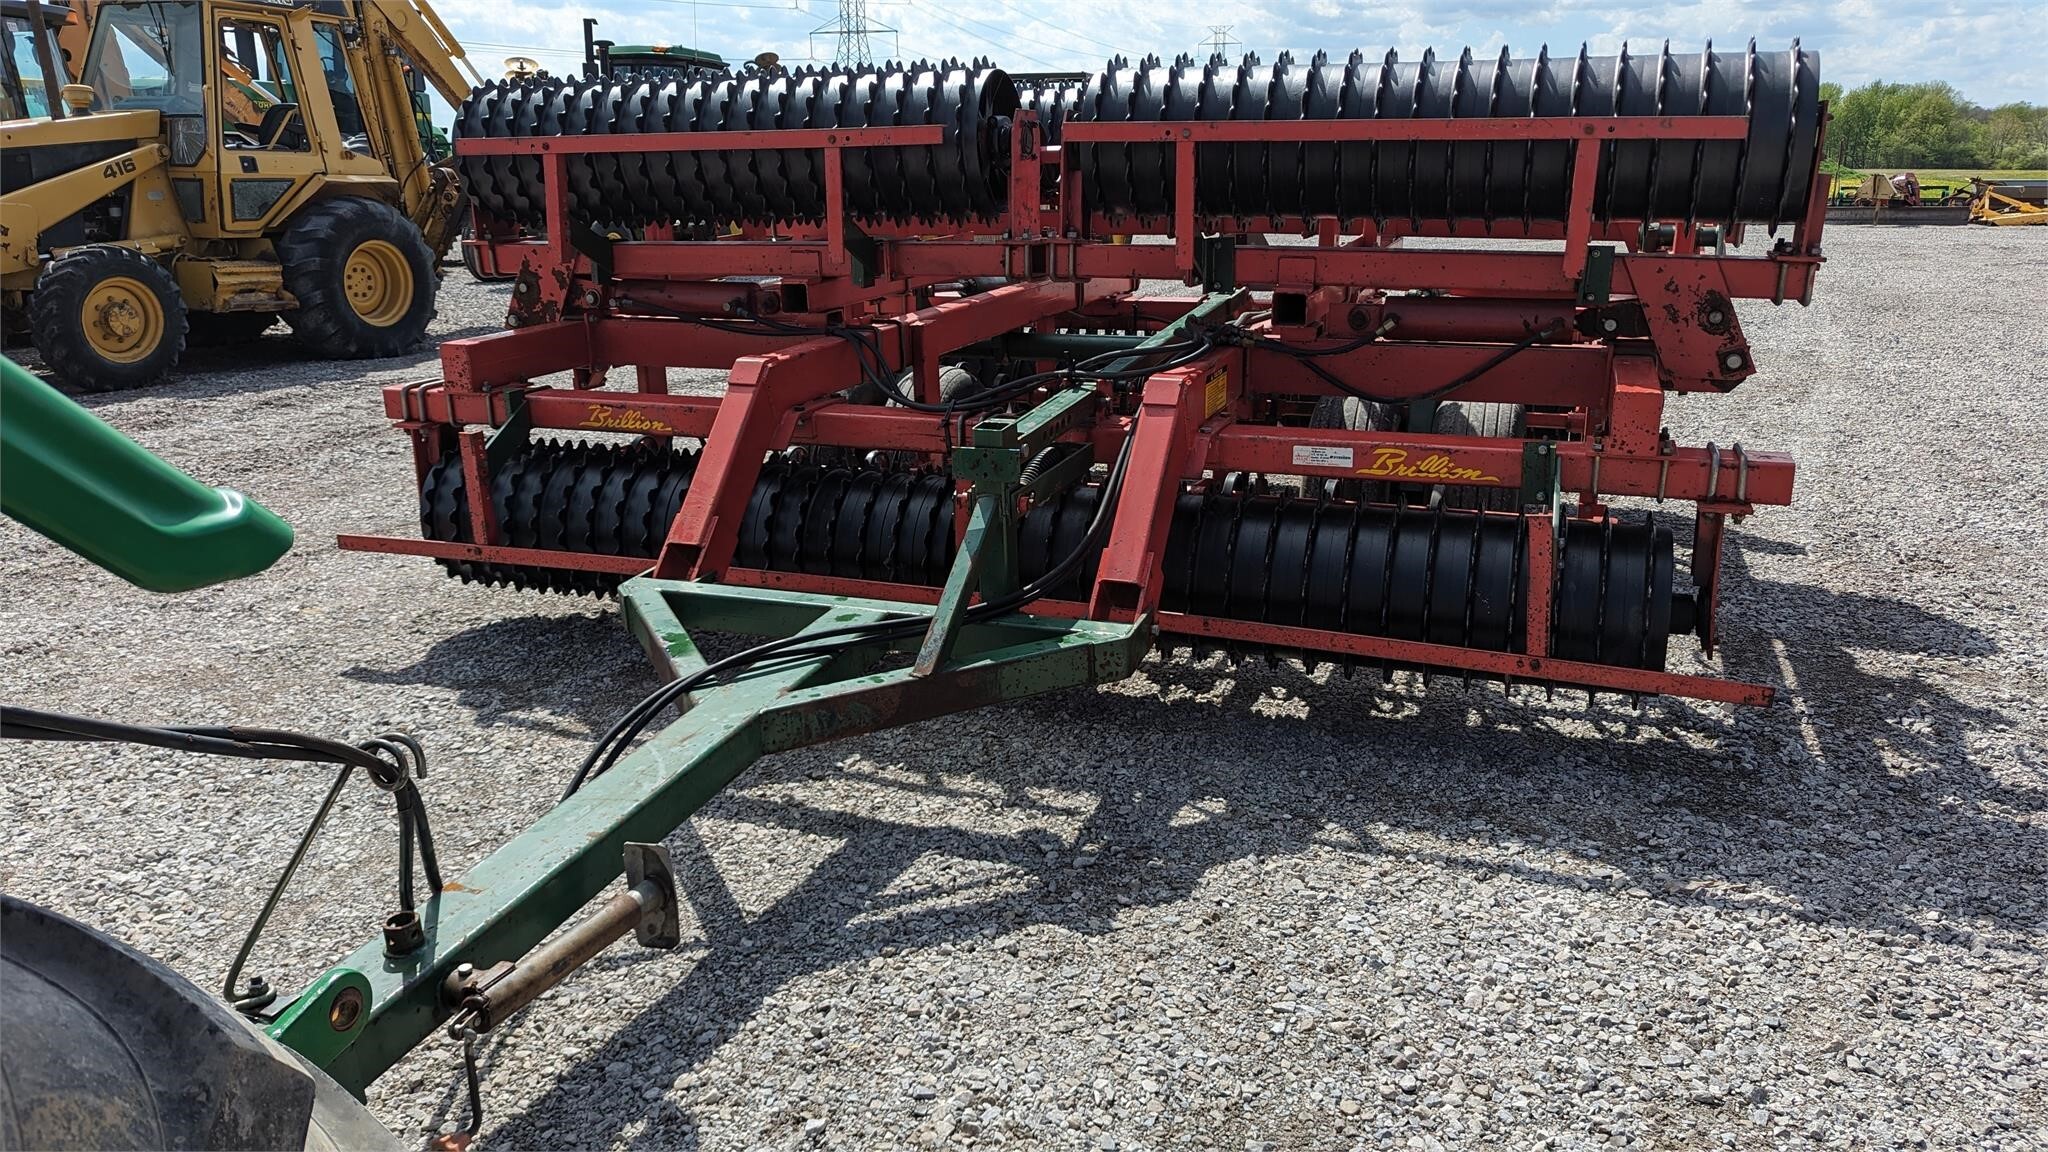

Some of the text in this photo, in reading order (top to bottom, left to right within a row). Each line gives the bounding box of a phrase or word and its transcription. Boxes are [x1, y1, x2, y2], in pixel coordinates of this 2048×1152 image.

[103, 157, 137, 179] 416
[579, 404, 672, 431] Brillion
[1355, 447, 1500, 482] Brillion
